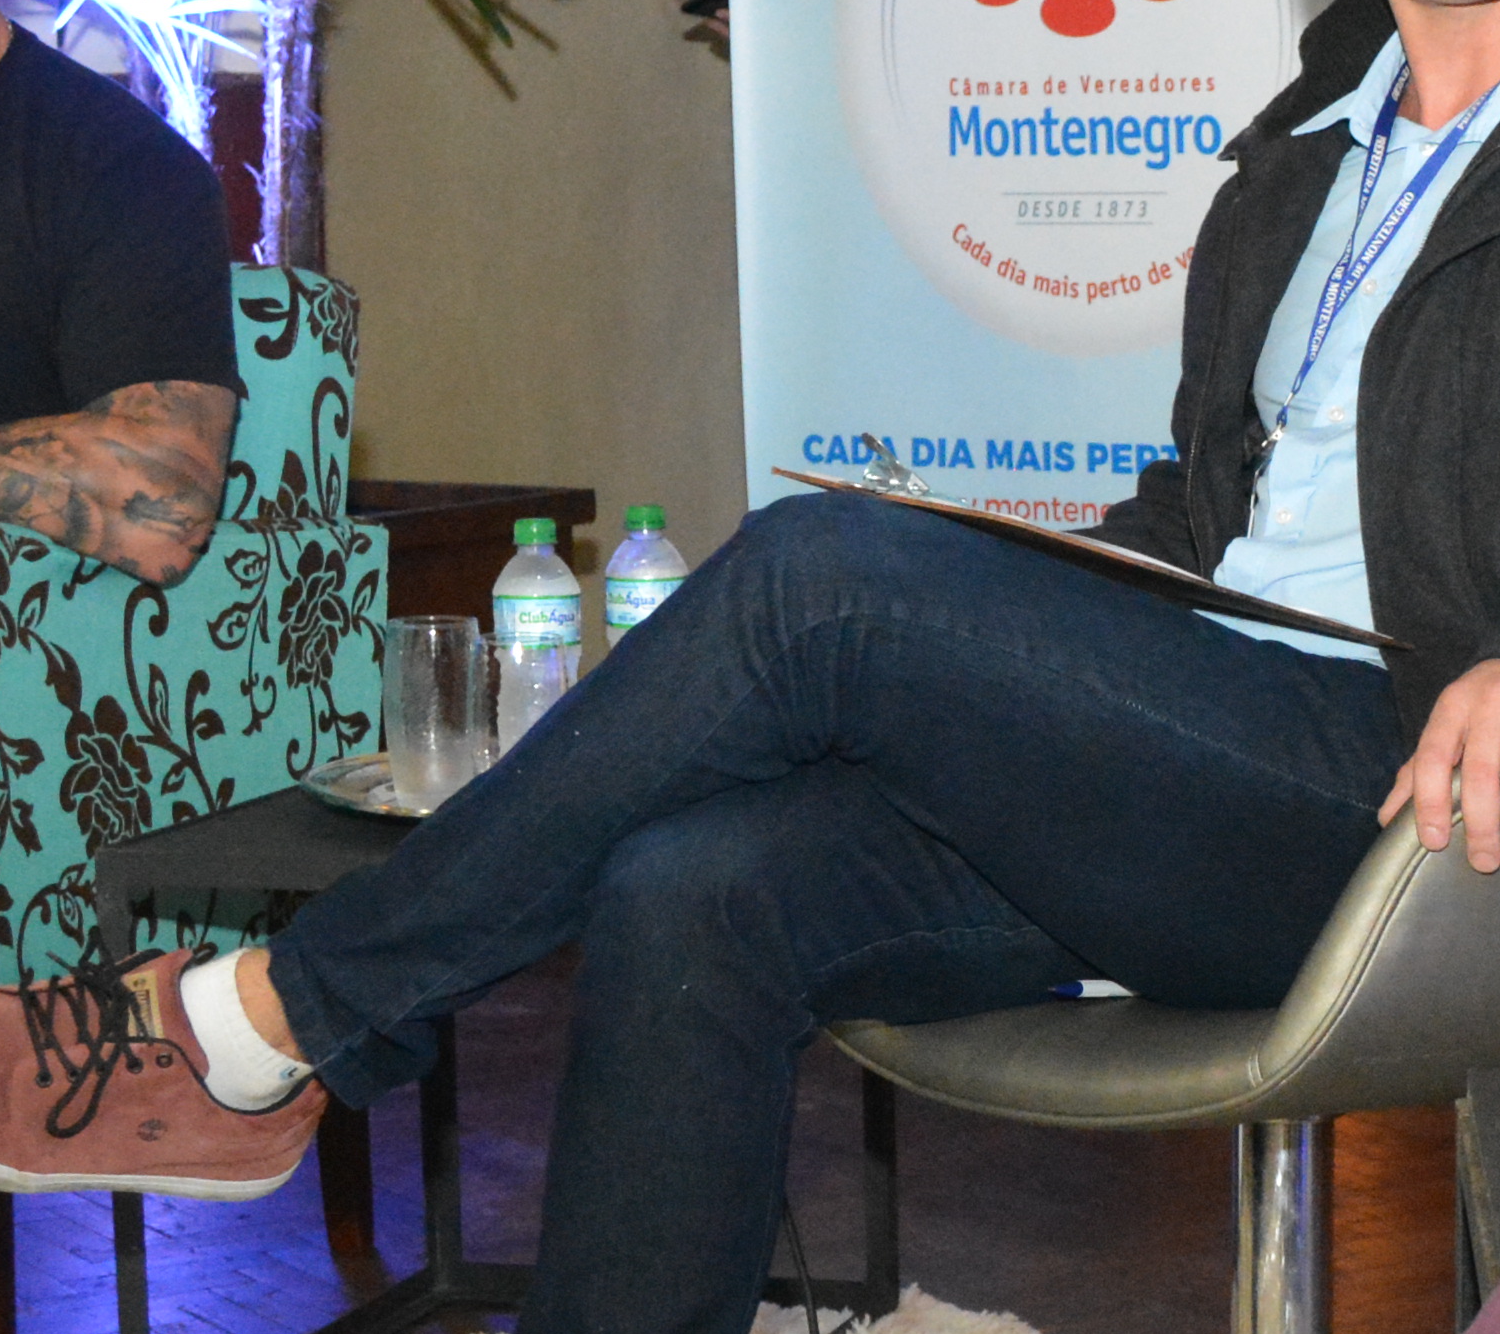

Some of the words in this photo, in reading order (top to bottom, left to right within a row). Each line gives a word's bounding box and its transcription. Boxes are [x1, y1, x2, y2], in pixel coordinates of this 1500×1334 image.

[949, 76, 1029, 96] Câmara
[1043, 75, 1067, 95] de
[1080, 73, 1216, 94] Vereadores
[949, 105, 1222, 170] Montenegro
[1017, 199, 1082, 218] DESDE
[1095, 199, 1149, 218] 1873
[1360, 190, 1416, 264] MONTENEGRO
[951, 223, 994, 267] Cada
[997, 257, 1027, 286] dia
[1033, 275, 1080, 299] mais
[1086, 273, 1142, 305] perto
[1148, 261, 1172, 286] de
[911, 436, 976, 469] DIA
[985, 439, 1076, 473] MAIS
[1087, 442, 1180, 474] PERT
